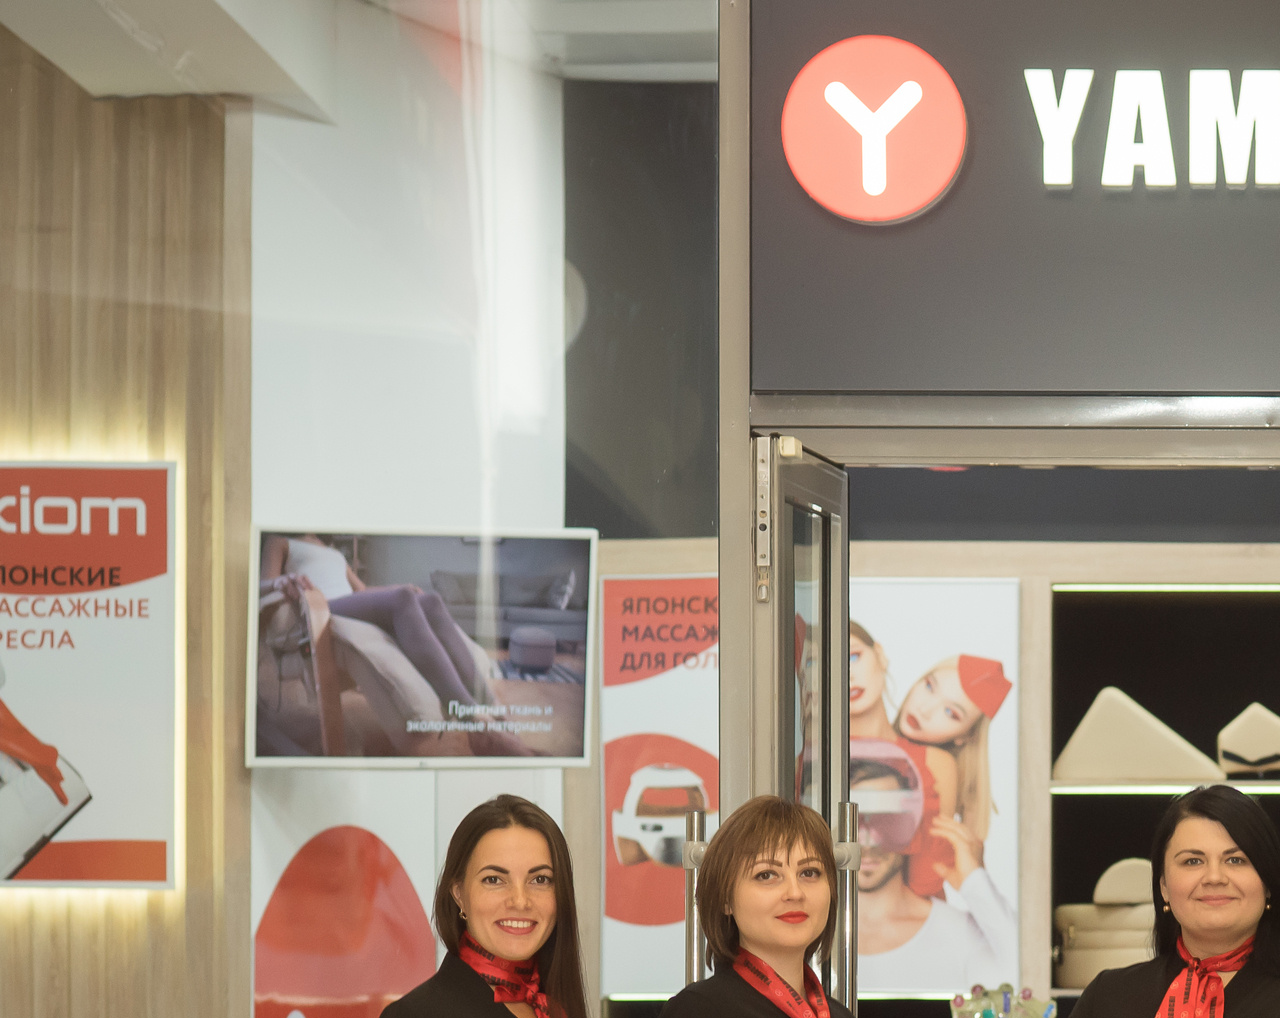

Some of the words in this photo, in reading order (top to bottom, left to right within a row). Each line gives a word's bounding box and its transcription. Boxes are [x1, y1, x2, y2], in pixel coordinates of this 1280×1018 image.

[622, 596, 718, 615] ЯПОНСК
[0, 629, 75, 649] ЕСЛА
[620, 652, 665, 673] ДЛЯ
[673, 652, 717, 670] ГОЛ
[449, 701, 507, 718] Приятная
[510, 704, 542, 716] ткань
[544, 704, 554, 716] и
[406, 719, 485, 733] экологичные
[487, 720, 552, 735] материалы
